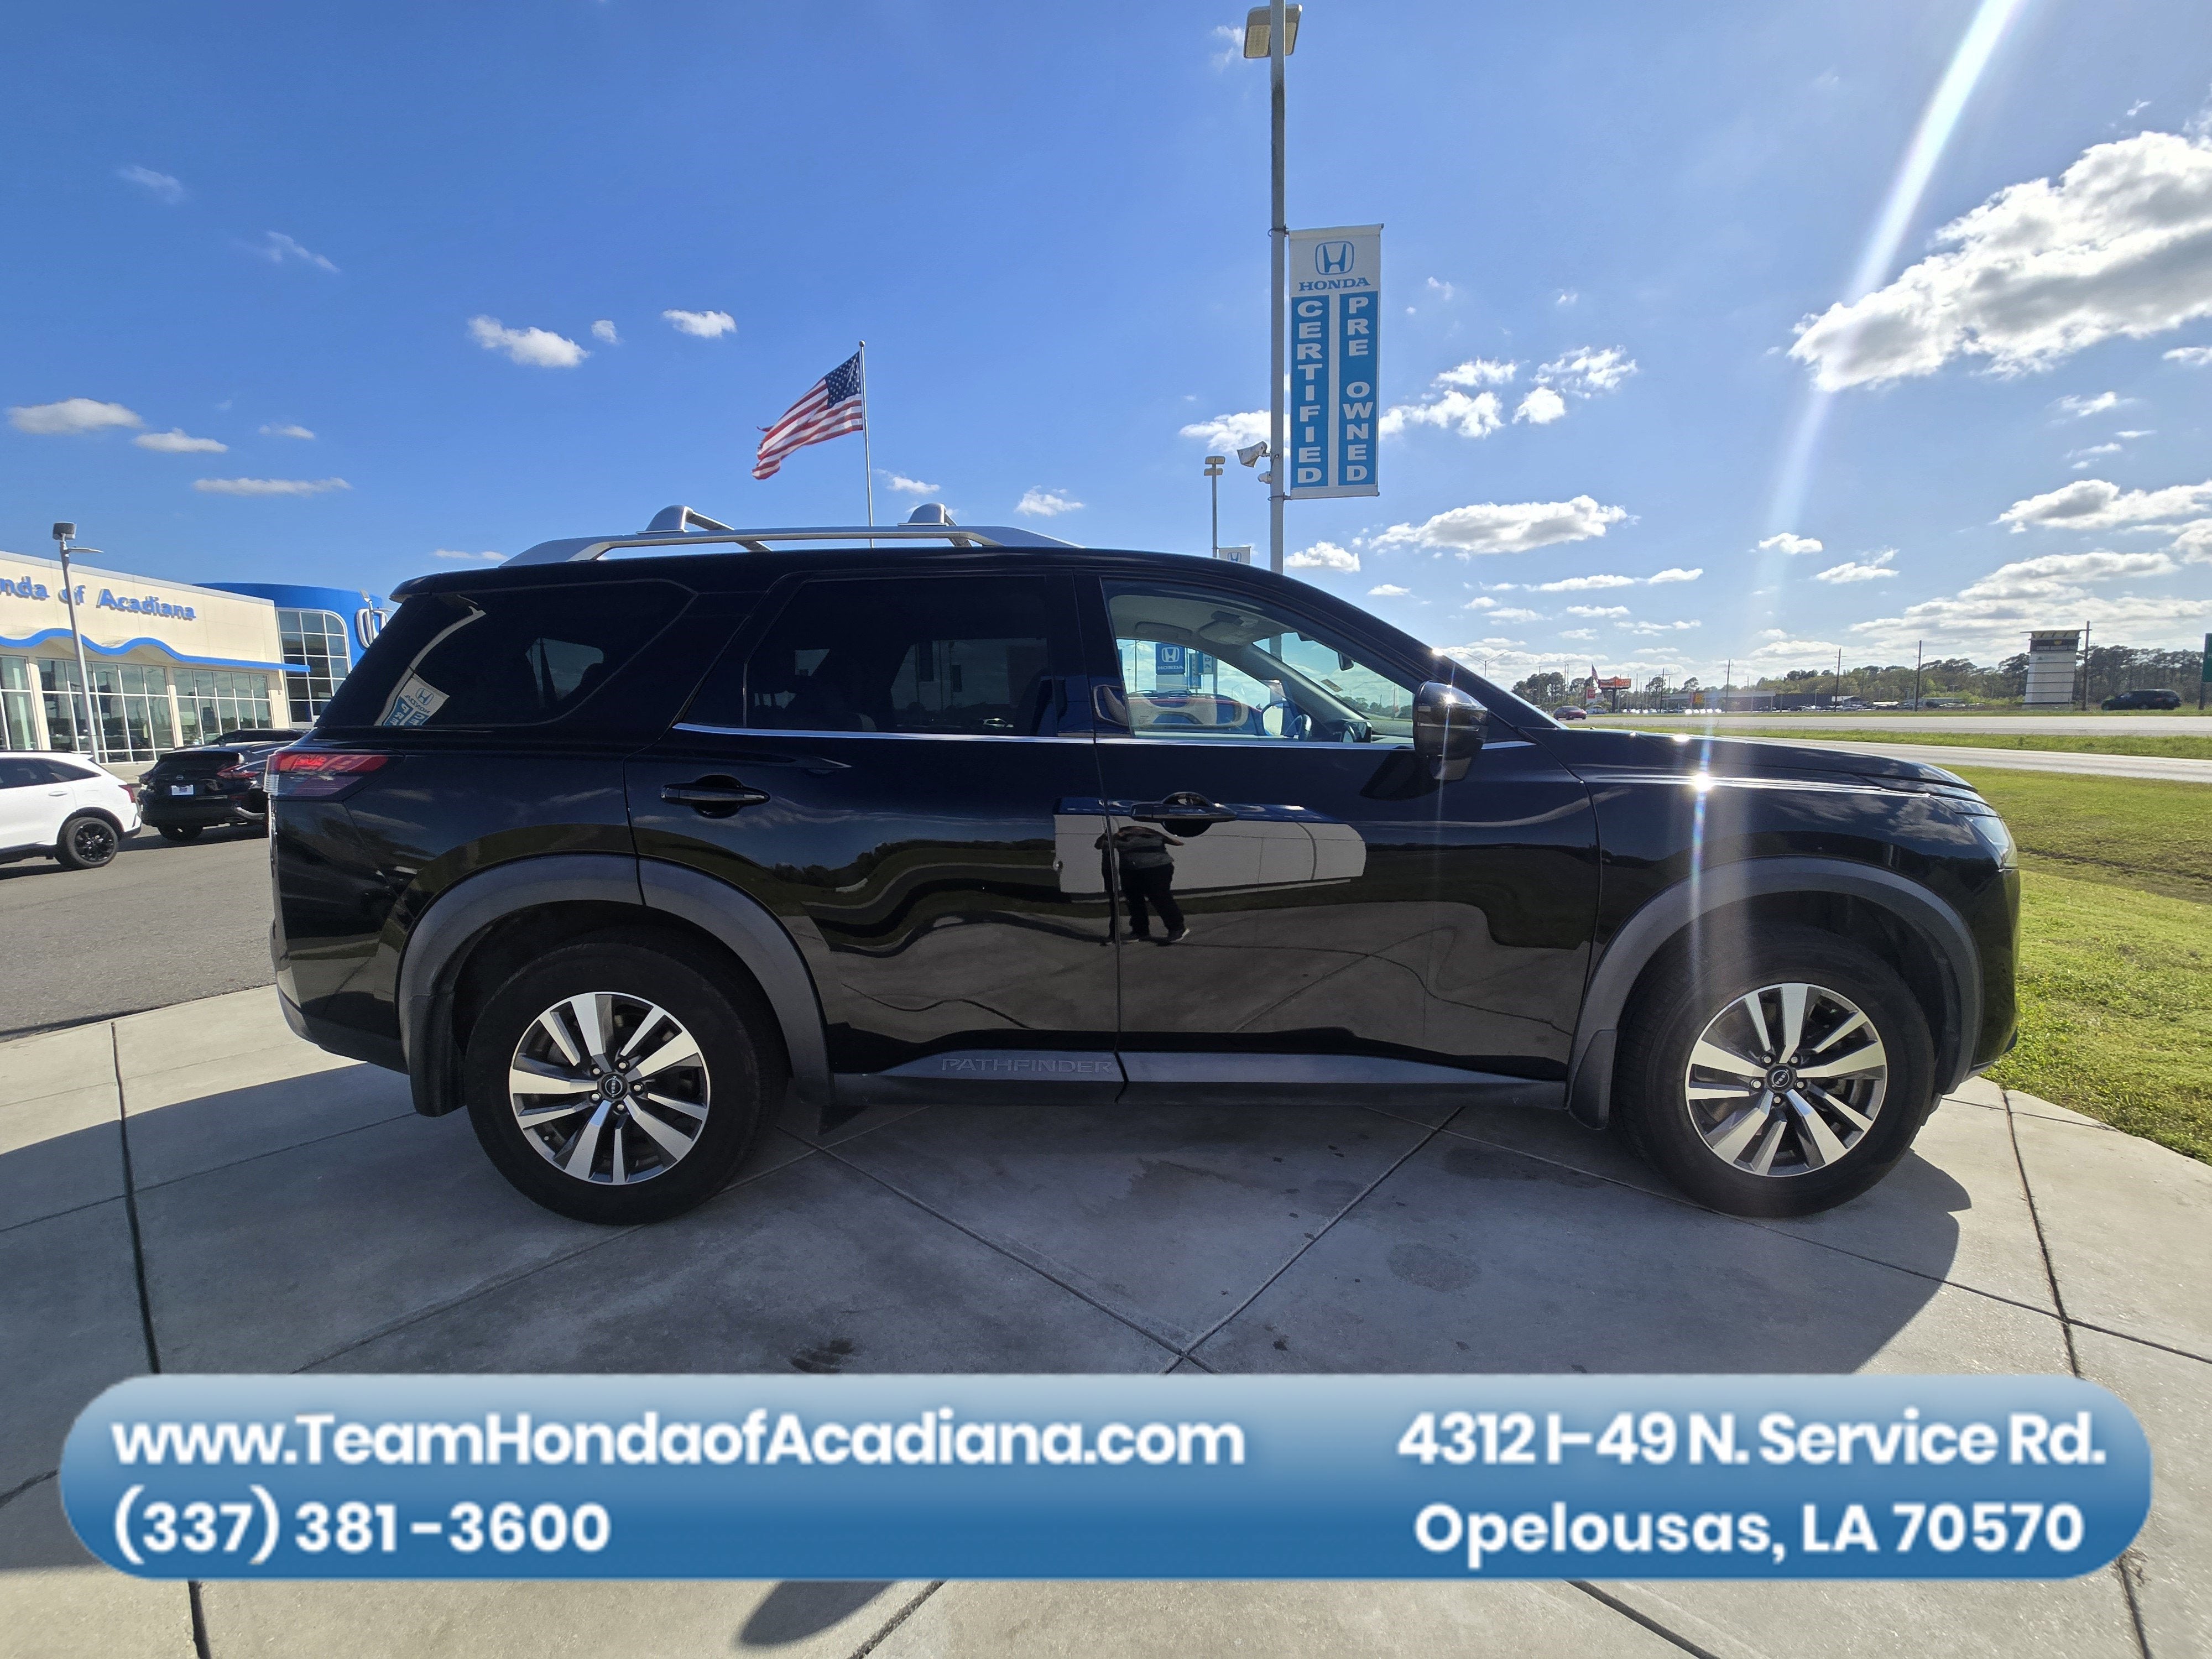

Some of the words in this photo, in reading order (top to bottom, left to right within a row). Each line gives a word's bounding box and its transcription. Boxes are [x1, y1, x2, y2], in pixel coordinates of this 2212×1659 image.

[1299, 277, 1370, 291] HONDA
[1347, 297, 1369, 356] PRE
[1297, 301, 1323, 483] CERTIFIED
[1343, 382, 1374, 481] OWNED
[96, 588, 196, 621] Acadiana
[942, 1058, 1113, 1073] PATHFINDER
